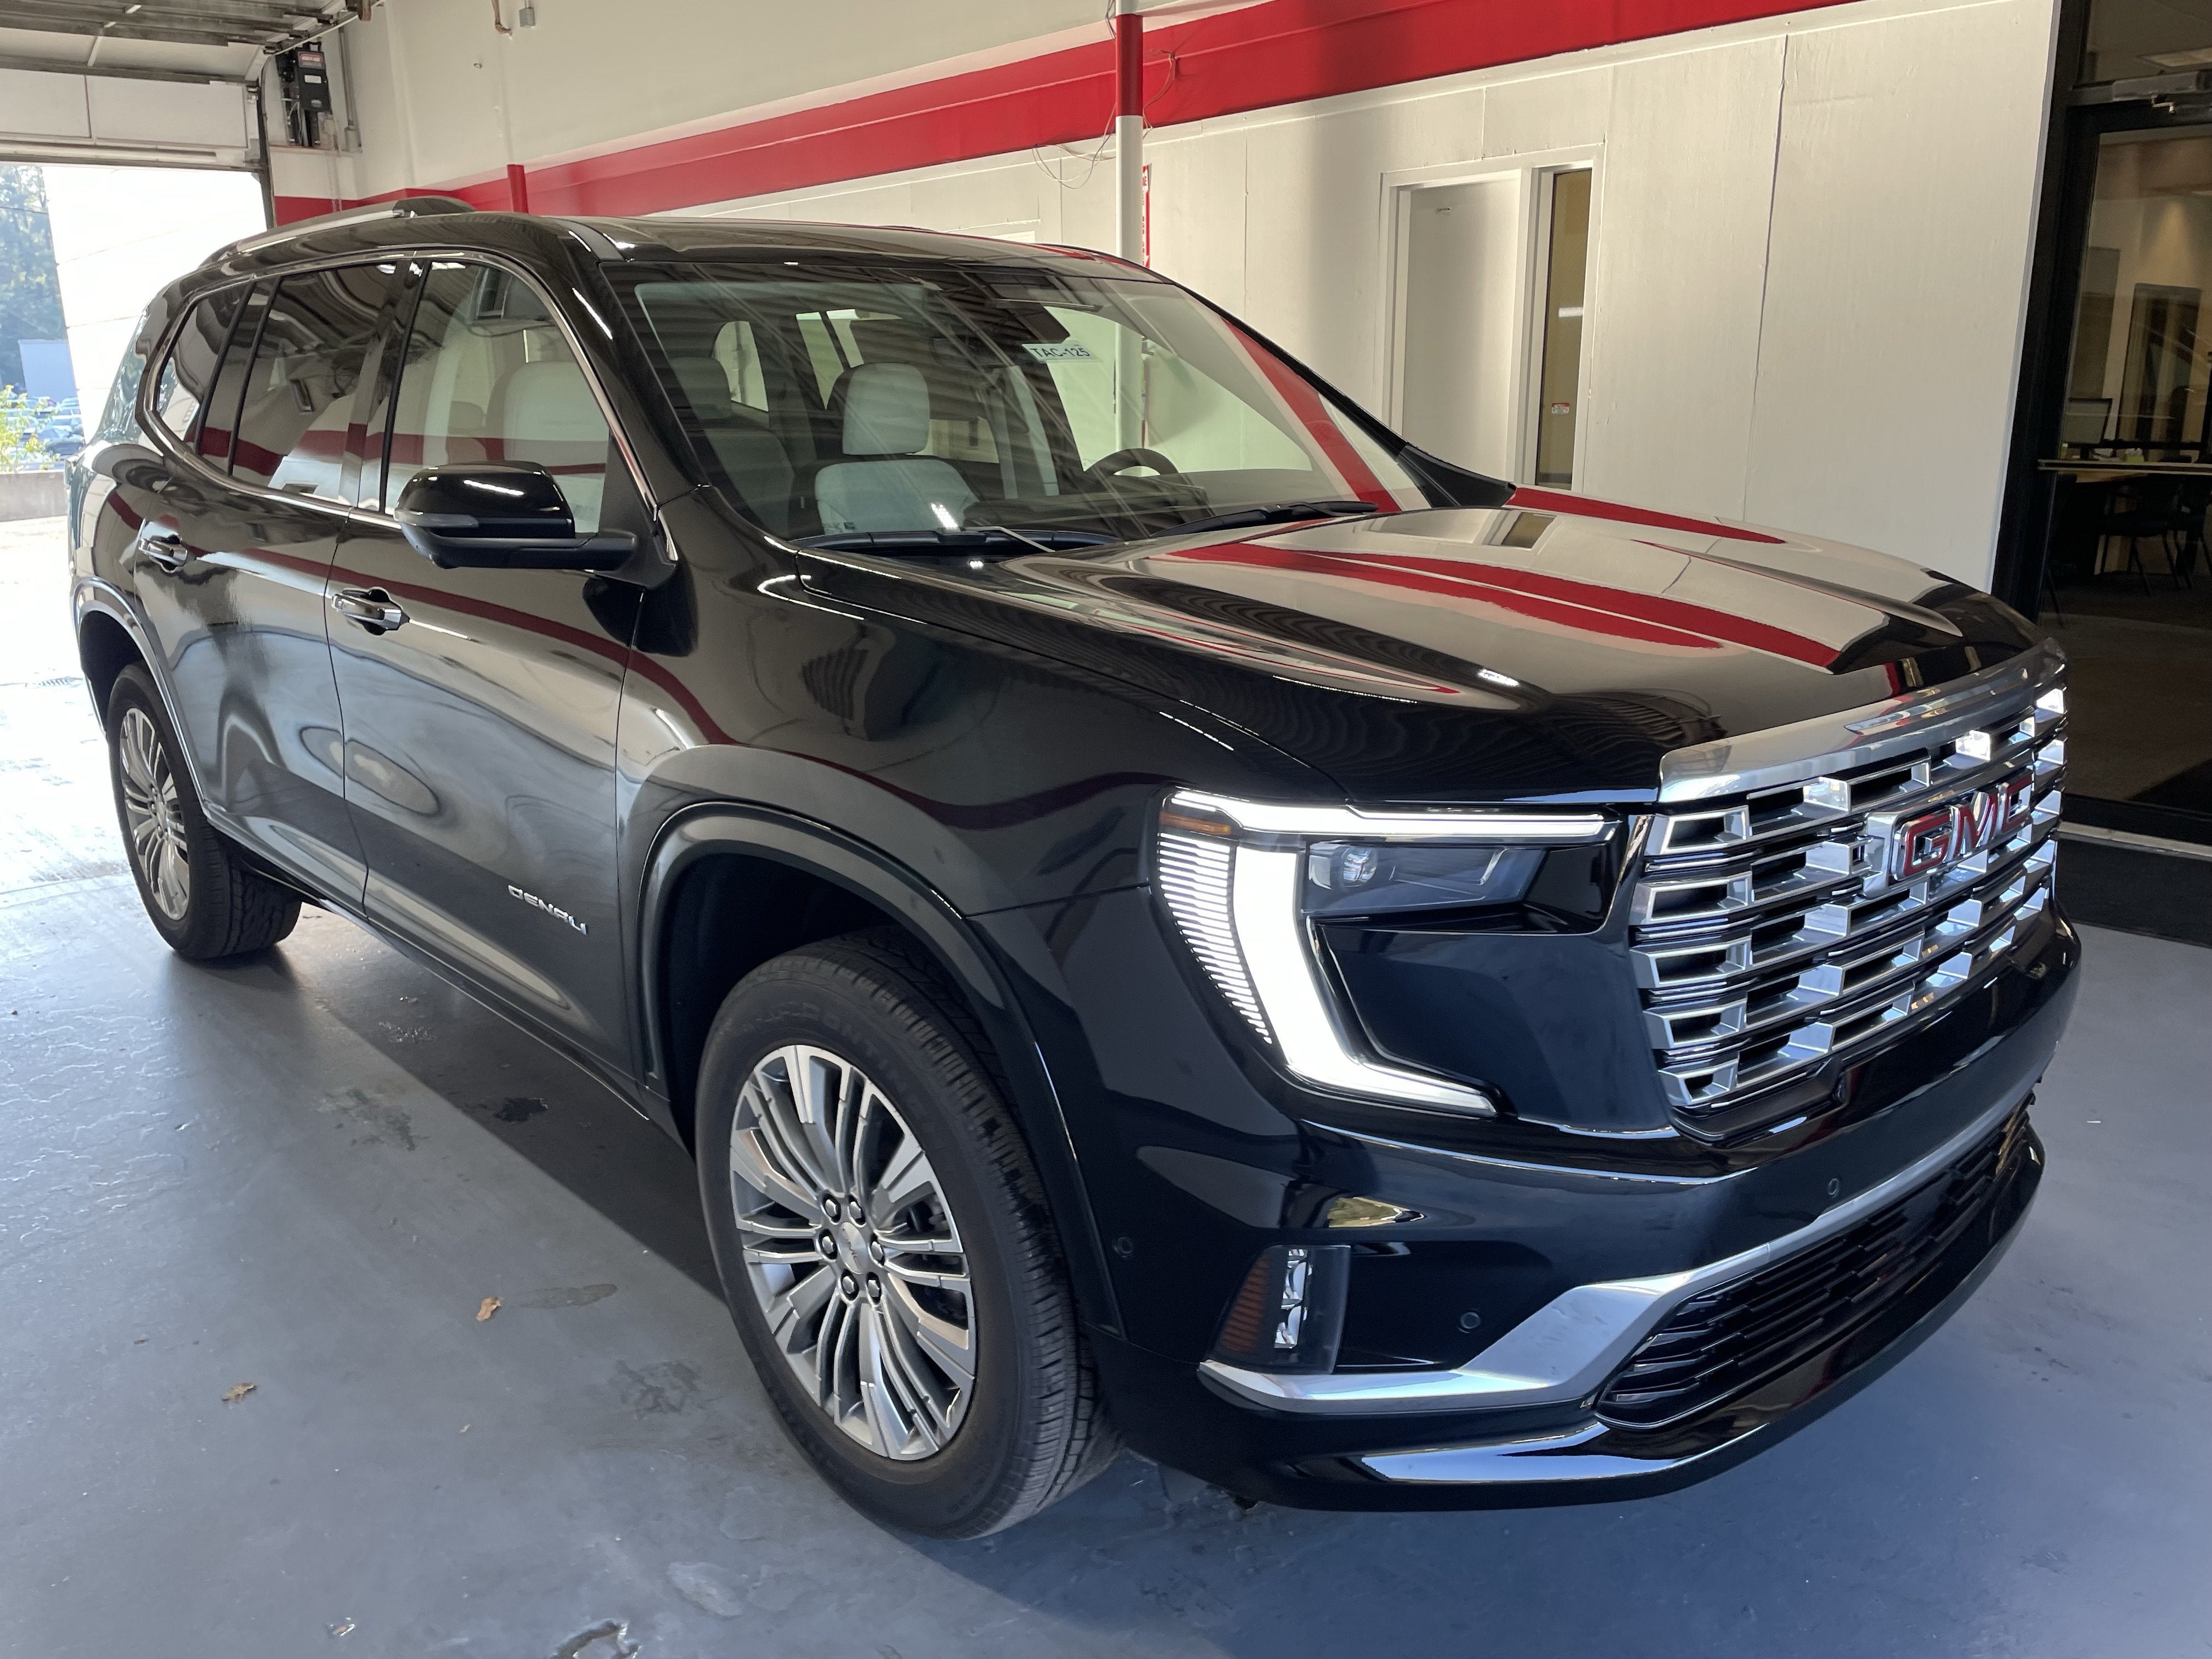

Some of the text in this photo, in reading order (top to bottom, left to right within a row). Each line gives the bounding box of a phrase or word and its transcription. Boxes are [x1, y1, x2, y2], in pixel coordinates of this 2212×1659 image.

[1029, 348, 1091, 357] TAC-125
[1890, 775, 2032, 880] GMC
[508, 884, 587, 935] DENALI
